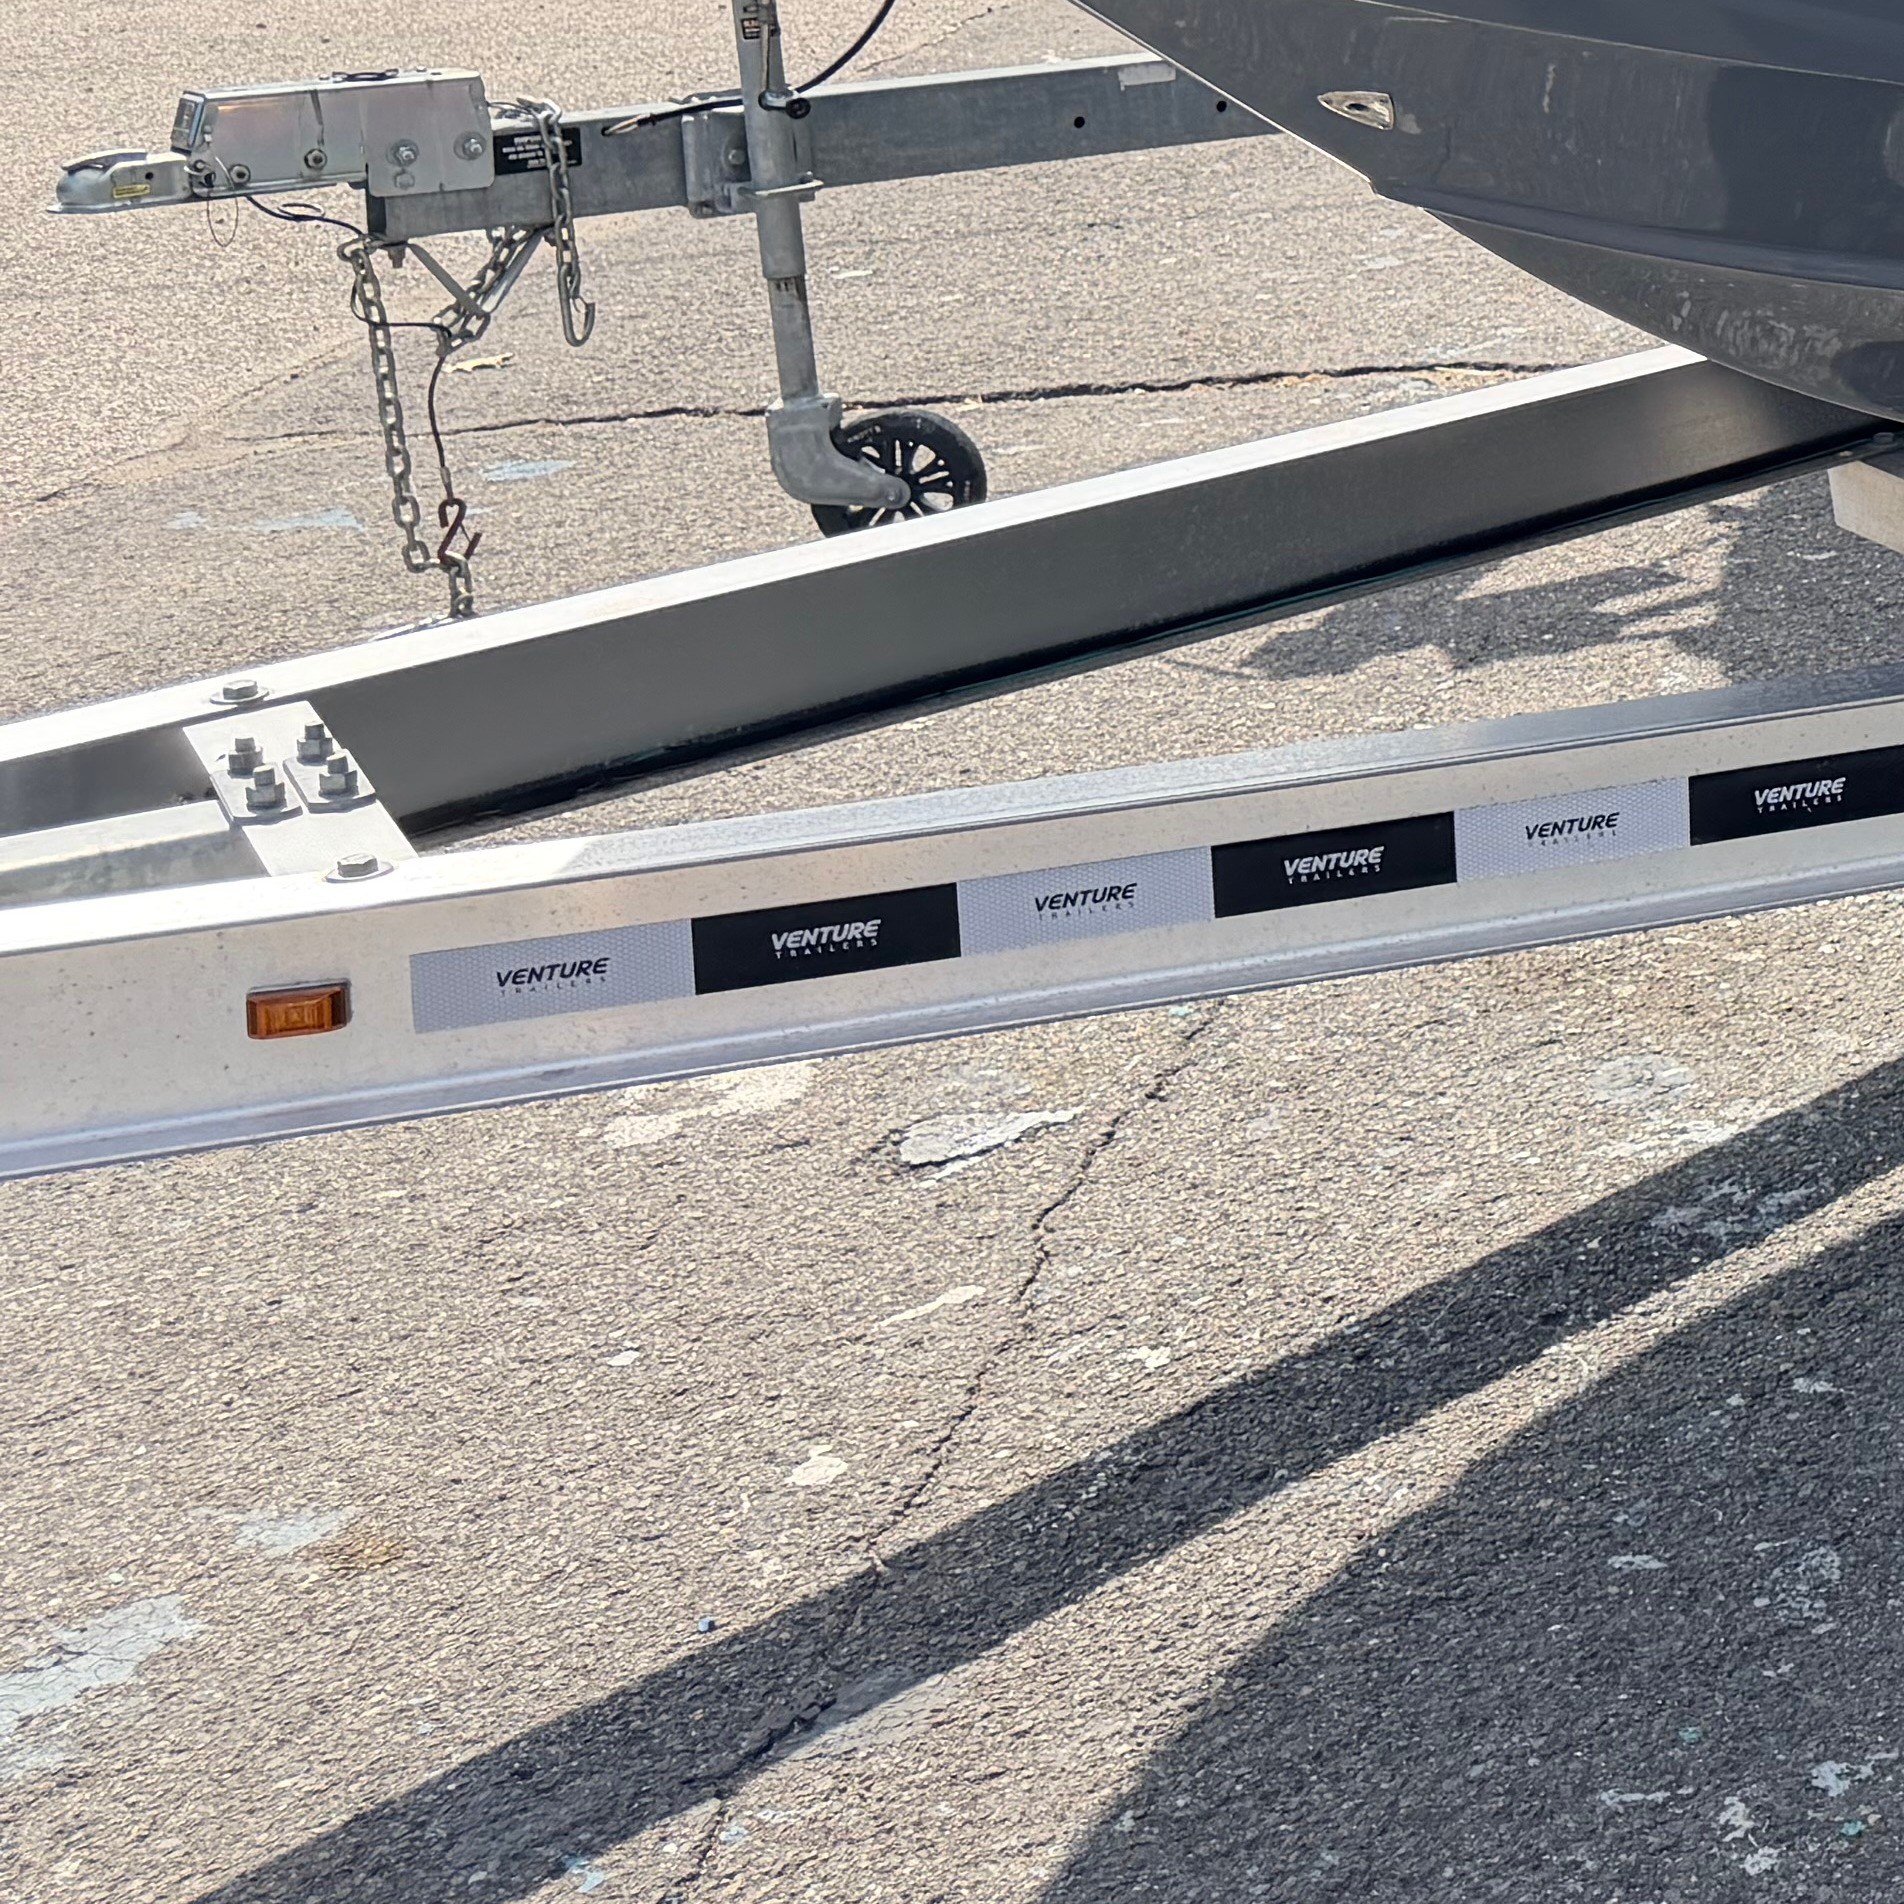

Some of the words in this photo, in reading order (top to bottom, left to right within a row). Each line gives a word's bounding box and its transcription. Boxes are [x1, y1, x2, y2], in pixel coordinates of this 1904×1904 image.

[1755, 777, 1846, 805] VENTURE
[1525, 812, 1620, 840] VENTURE
[1284, 846, 1384, 876] VENTURE
[1035, 882, 1137, 911] VENTURE
[771, 919, 881, 950] VENTURE
[775, 938, 877, 959] TRAILERS
[497, 957, 610, 987] VENTURE
